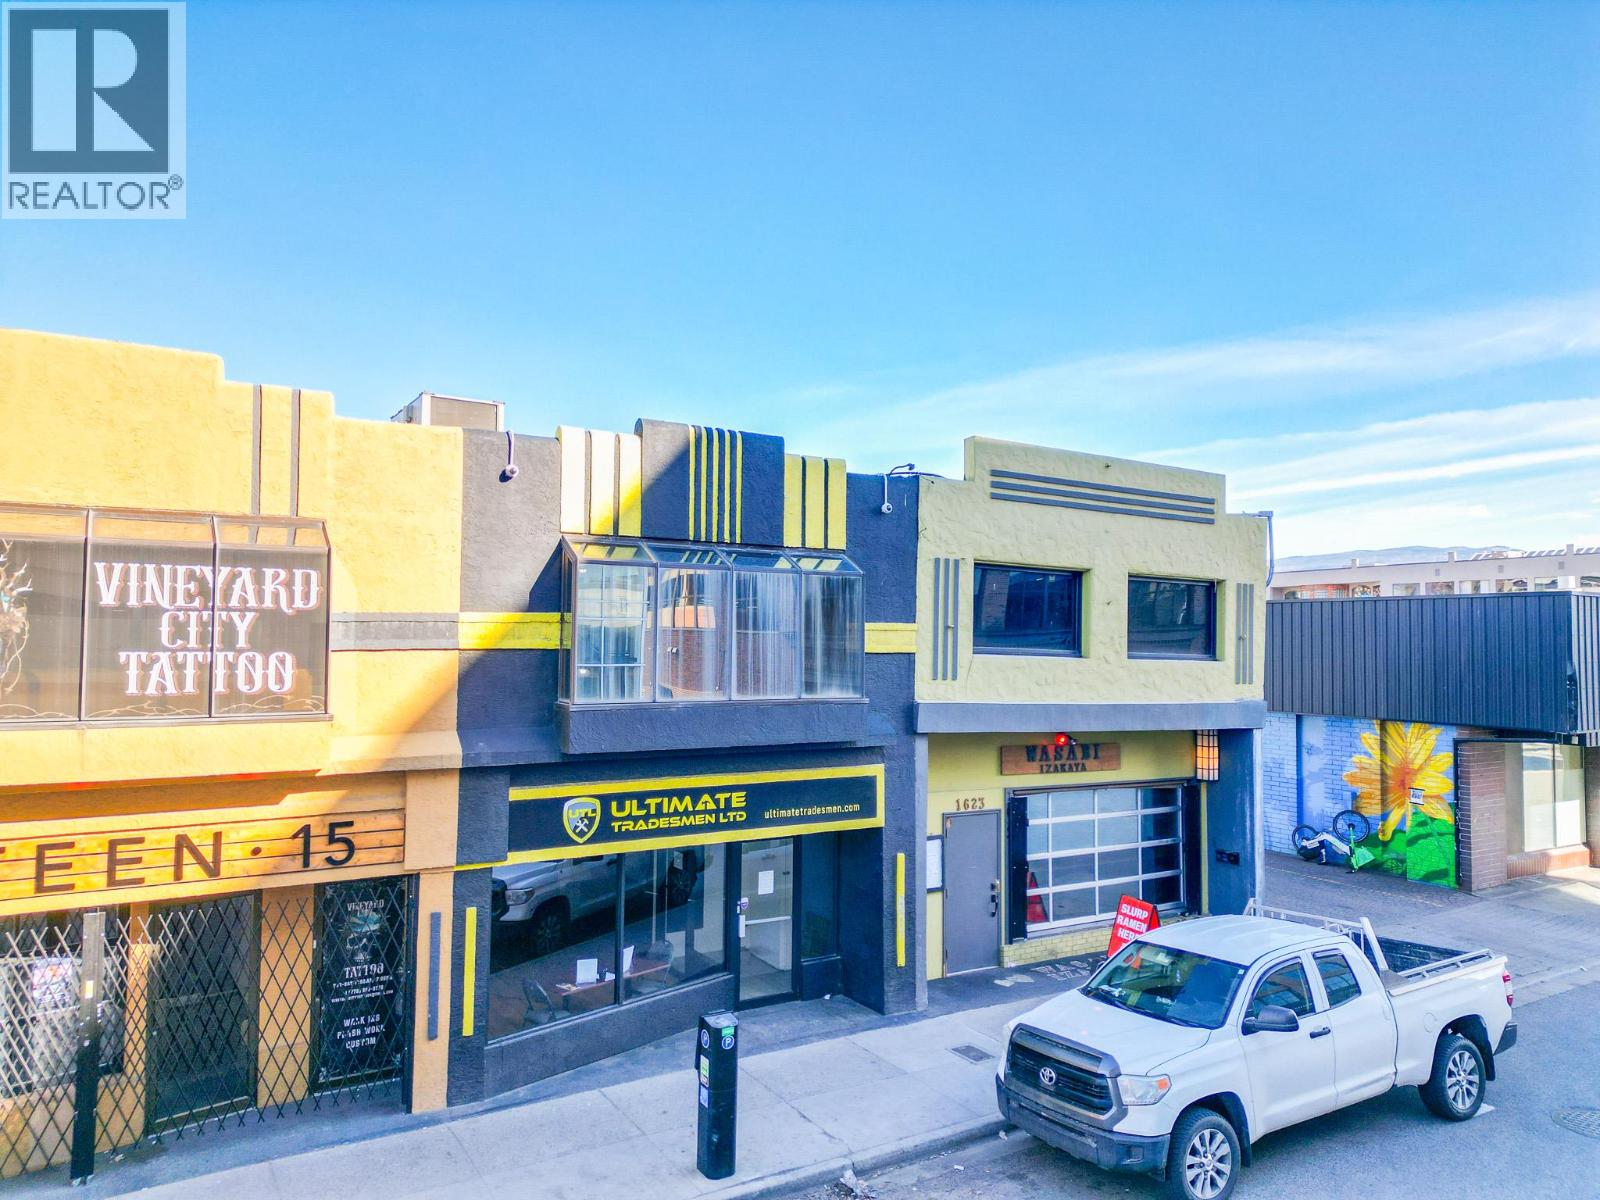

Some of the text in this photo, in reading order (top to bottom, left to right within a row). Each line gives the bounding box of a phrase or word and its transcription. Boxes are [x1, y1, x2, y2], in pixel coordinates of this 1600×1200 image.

[93, 562, 322, 613] VINEYARD
[159, 611, 258, 649] CITY
[119, 651, 296, 695] TATTOO
[1040, 762, 1087, 774] IZAKAYA
[611, 791, 747, 818] ULTIMATE
[764, 803, 860, 819] ultimatetradesmen.com
[955, 797, 985, 811] 1623
[611, 811, 747, 832] TRADESMEN LTD
[0, 820, 355, 895] EEN 15
[1120, 903, 1149, 920] SLURP
[1116, 914, 1148, 934] RAMEN
